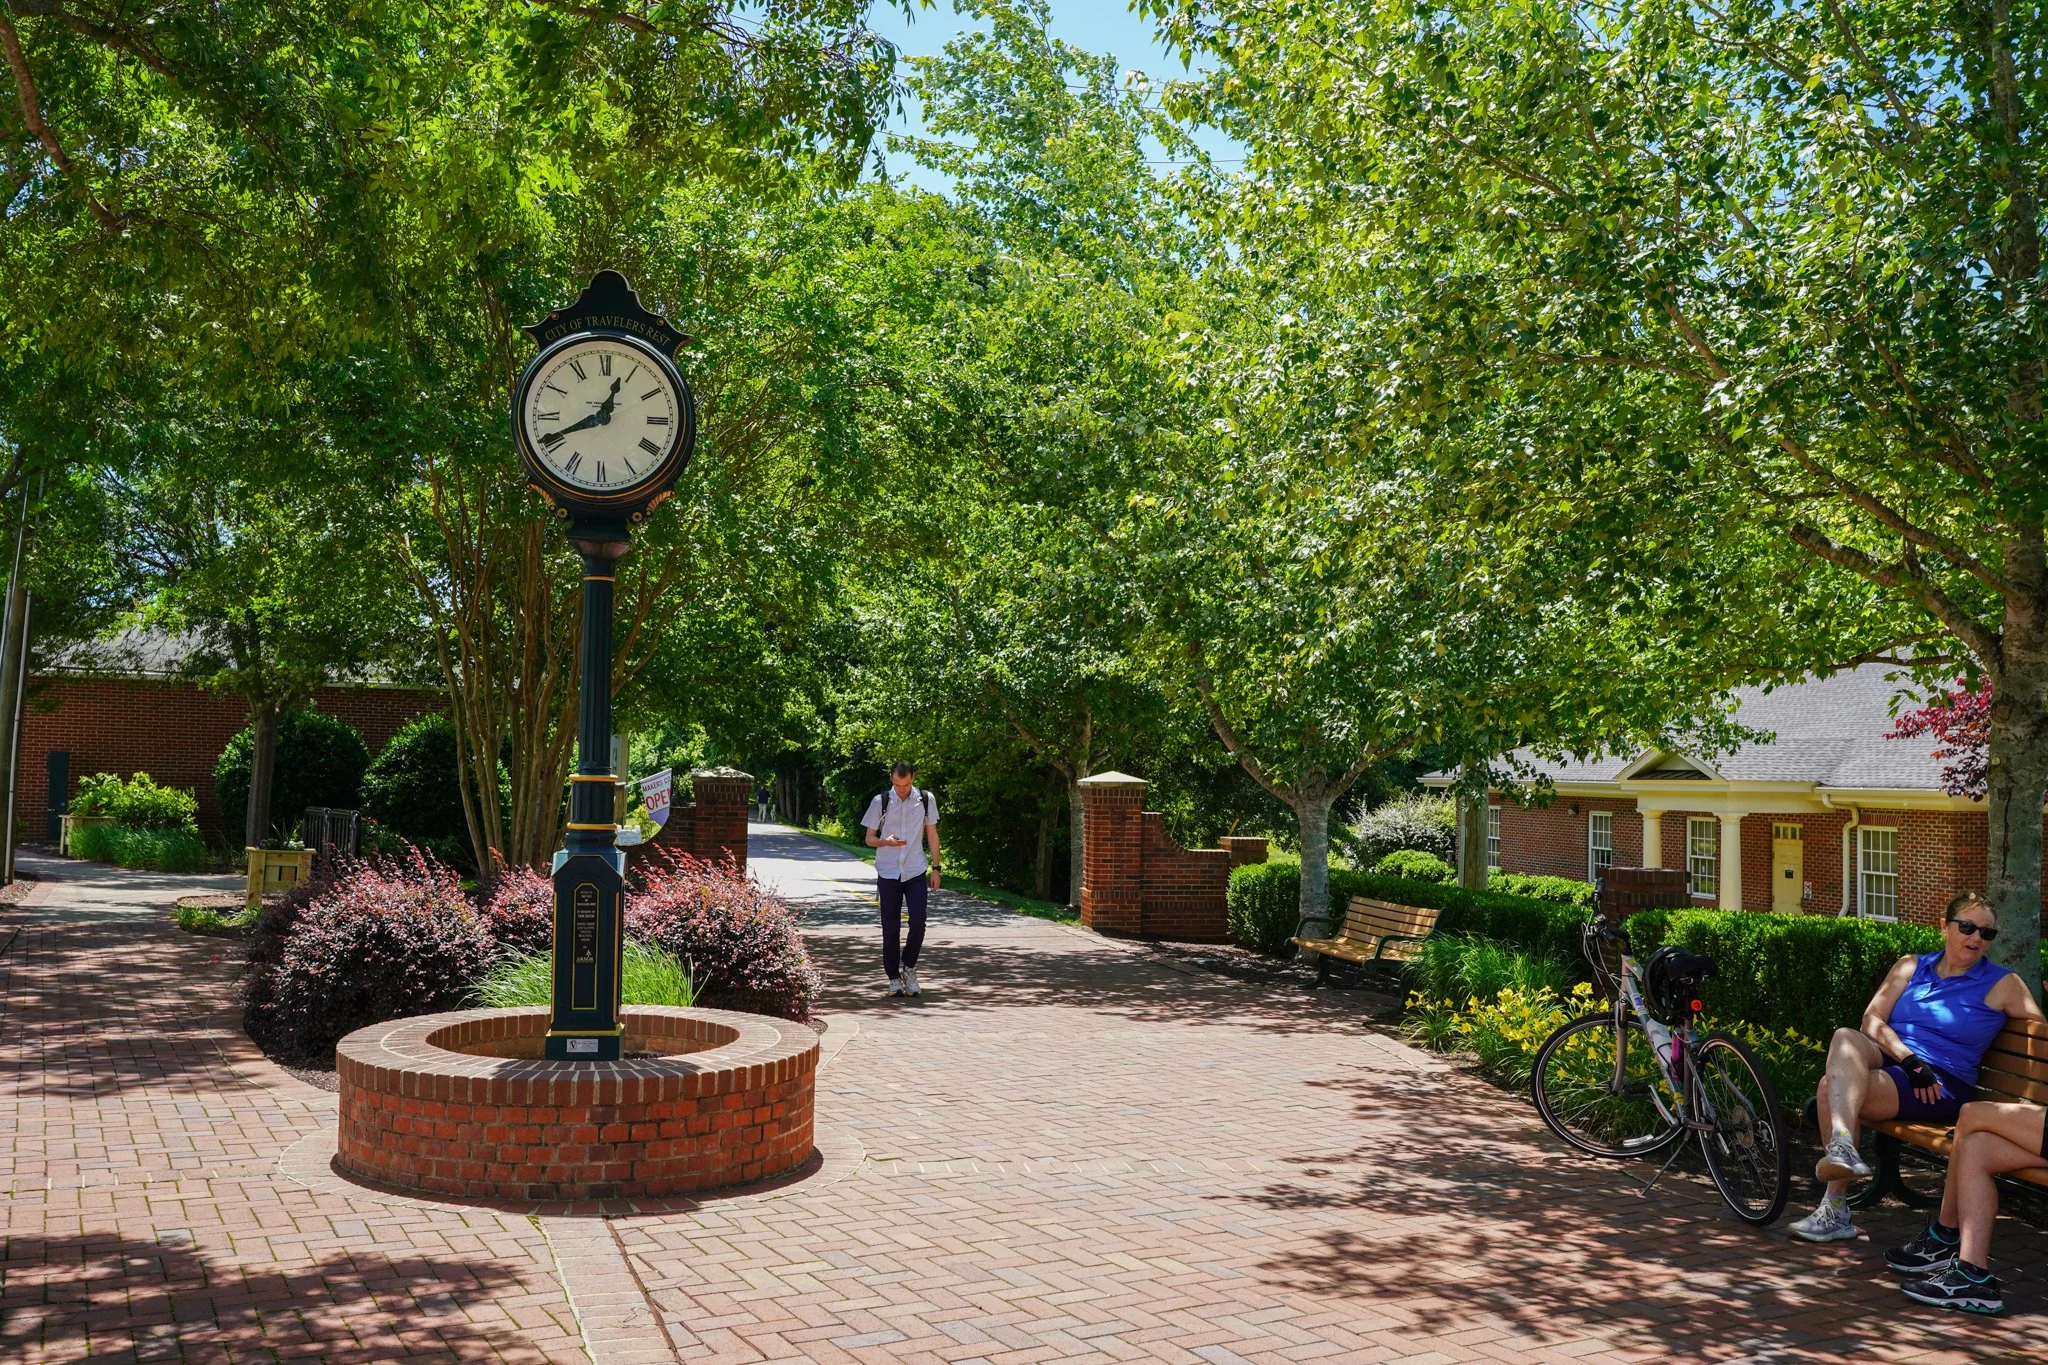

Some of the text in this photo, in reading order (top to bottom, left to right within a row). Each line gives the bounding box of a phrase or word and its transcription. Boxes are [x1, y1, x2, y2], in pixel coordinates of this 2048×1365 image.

[545, 315, 671, 347] CITY OF TRAVELERS REST
[642, 779, 664, 792] MAKERS
